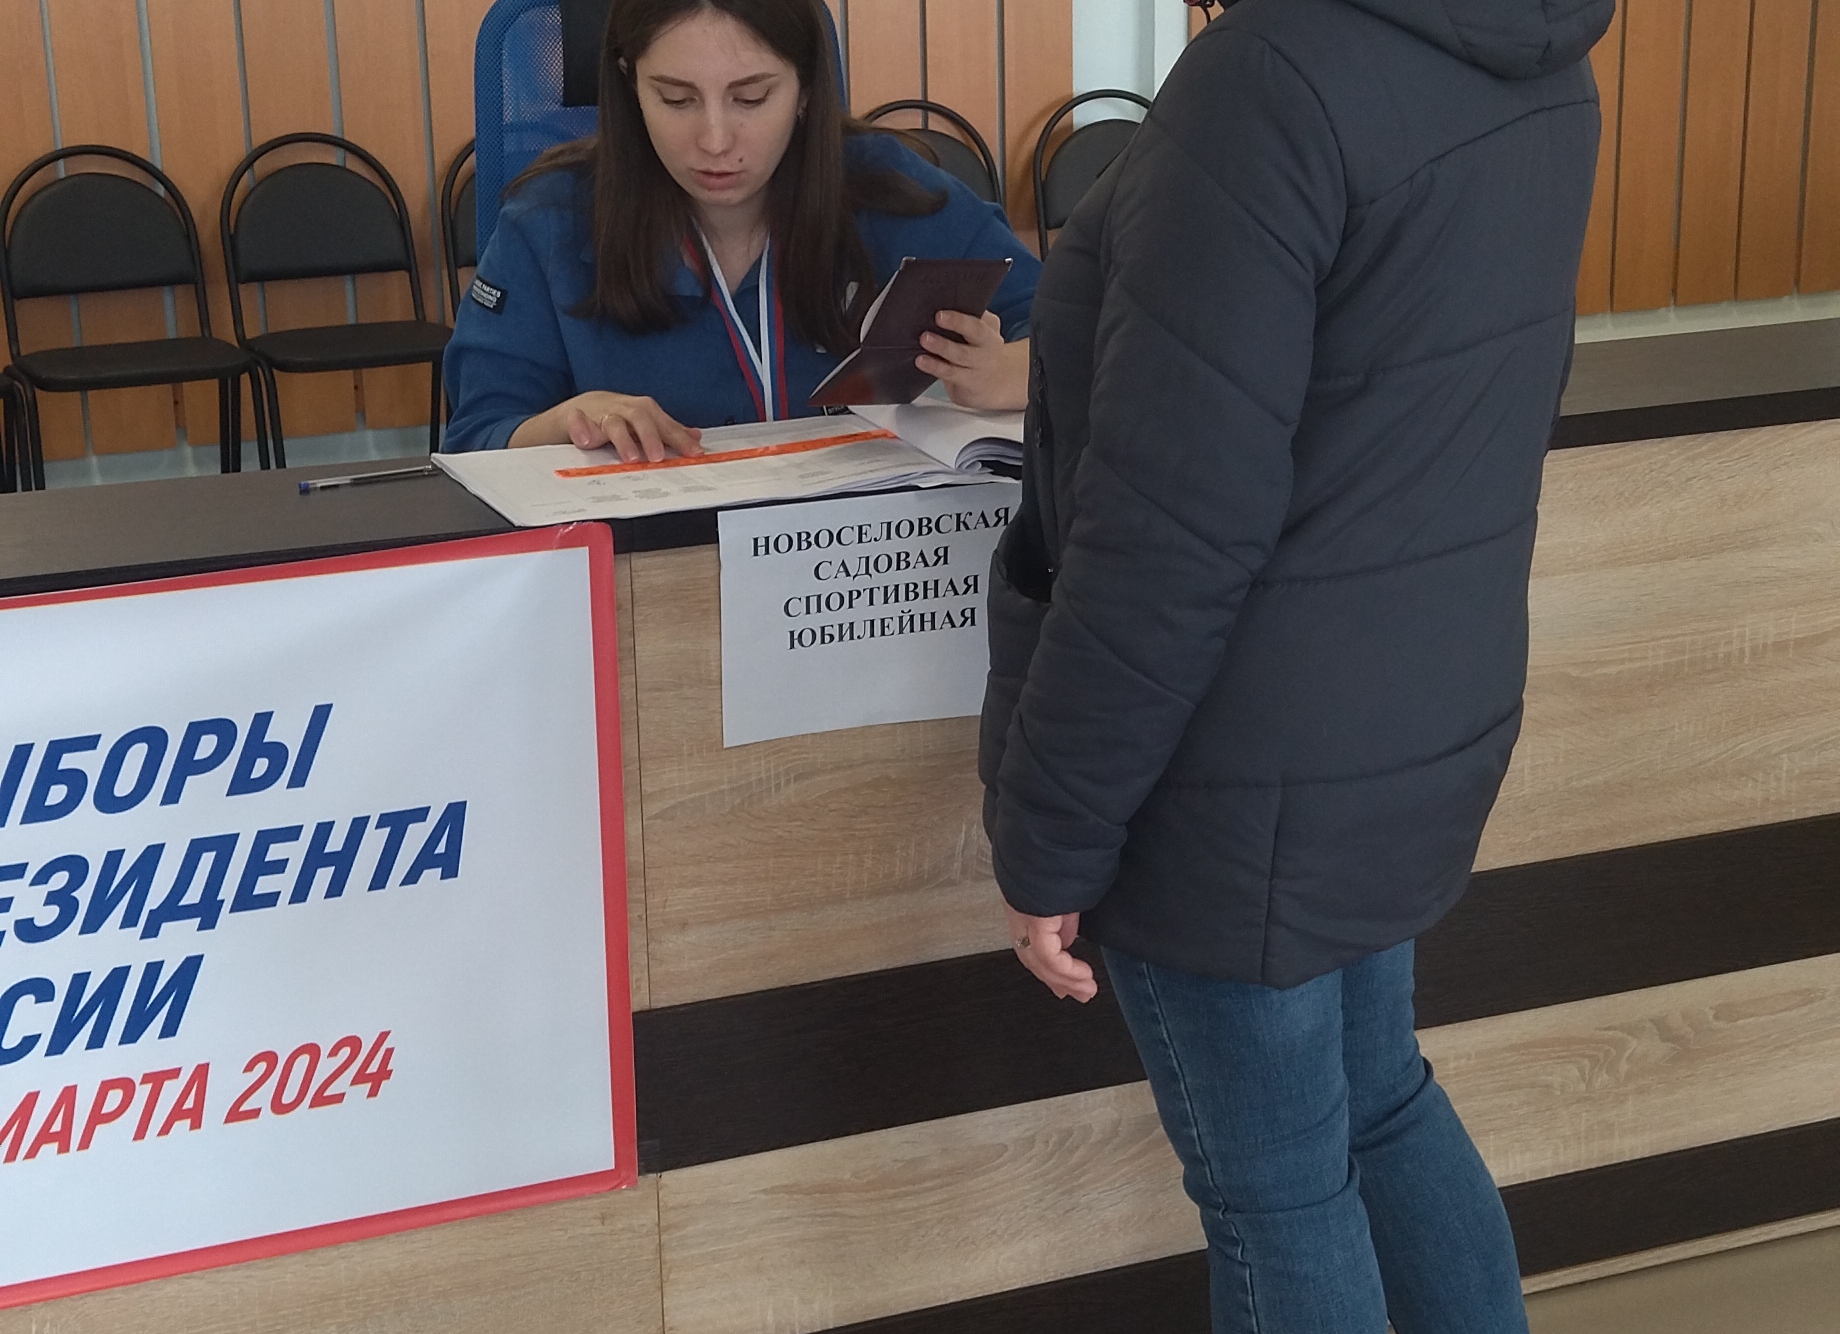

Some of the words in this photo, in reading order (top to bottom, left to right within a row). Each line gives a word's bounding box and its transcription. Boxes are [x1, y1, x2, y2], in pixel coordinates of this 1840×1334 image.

[752, 506, 1011, 557] НОВОСЕЛОВСКАЯ
[813, 545, 950, 581] САДОВАЯ
[783, 574, 980, 618] СПОРТИВНАЯ
[788, 606, 977, 650] ЮБИЛЕЙНАЯ
[0, 800, 467, 948] ЗИДЕНТА
[0, 954, 205, 1066] СИИ
[224, 1030, 395, 1125] 2024
